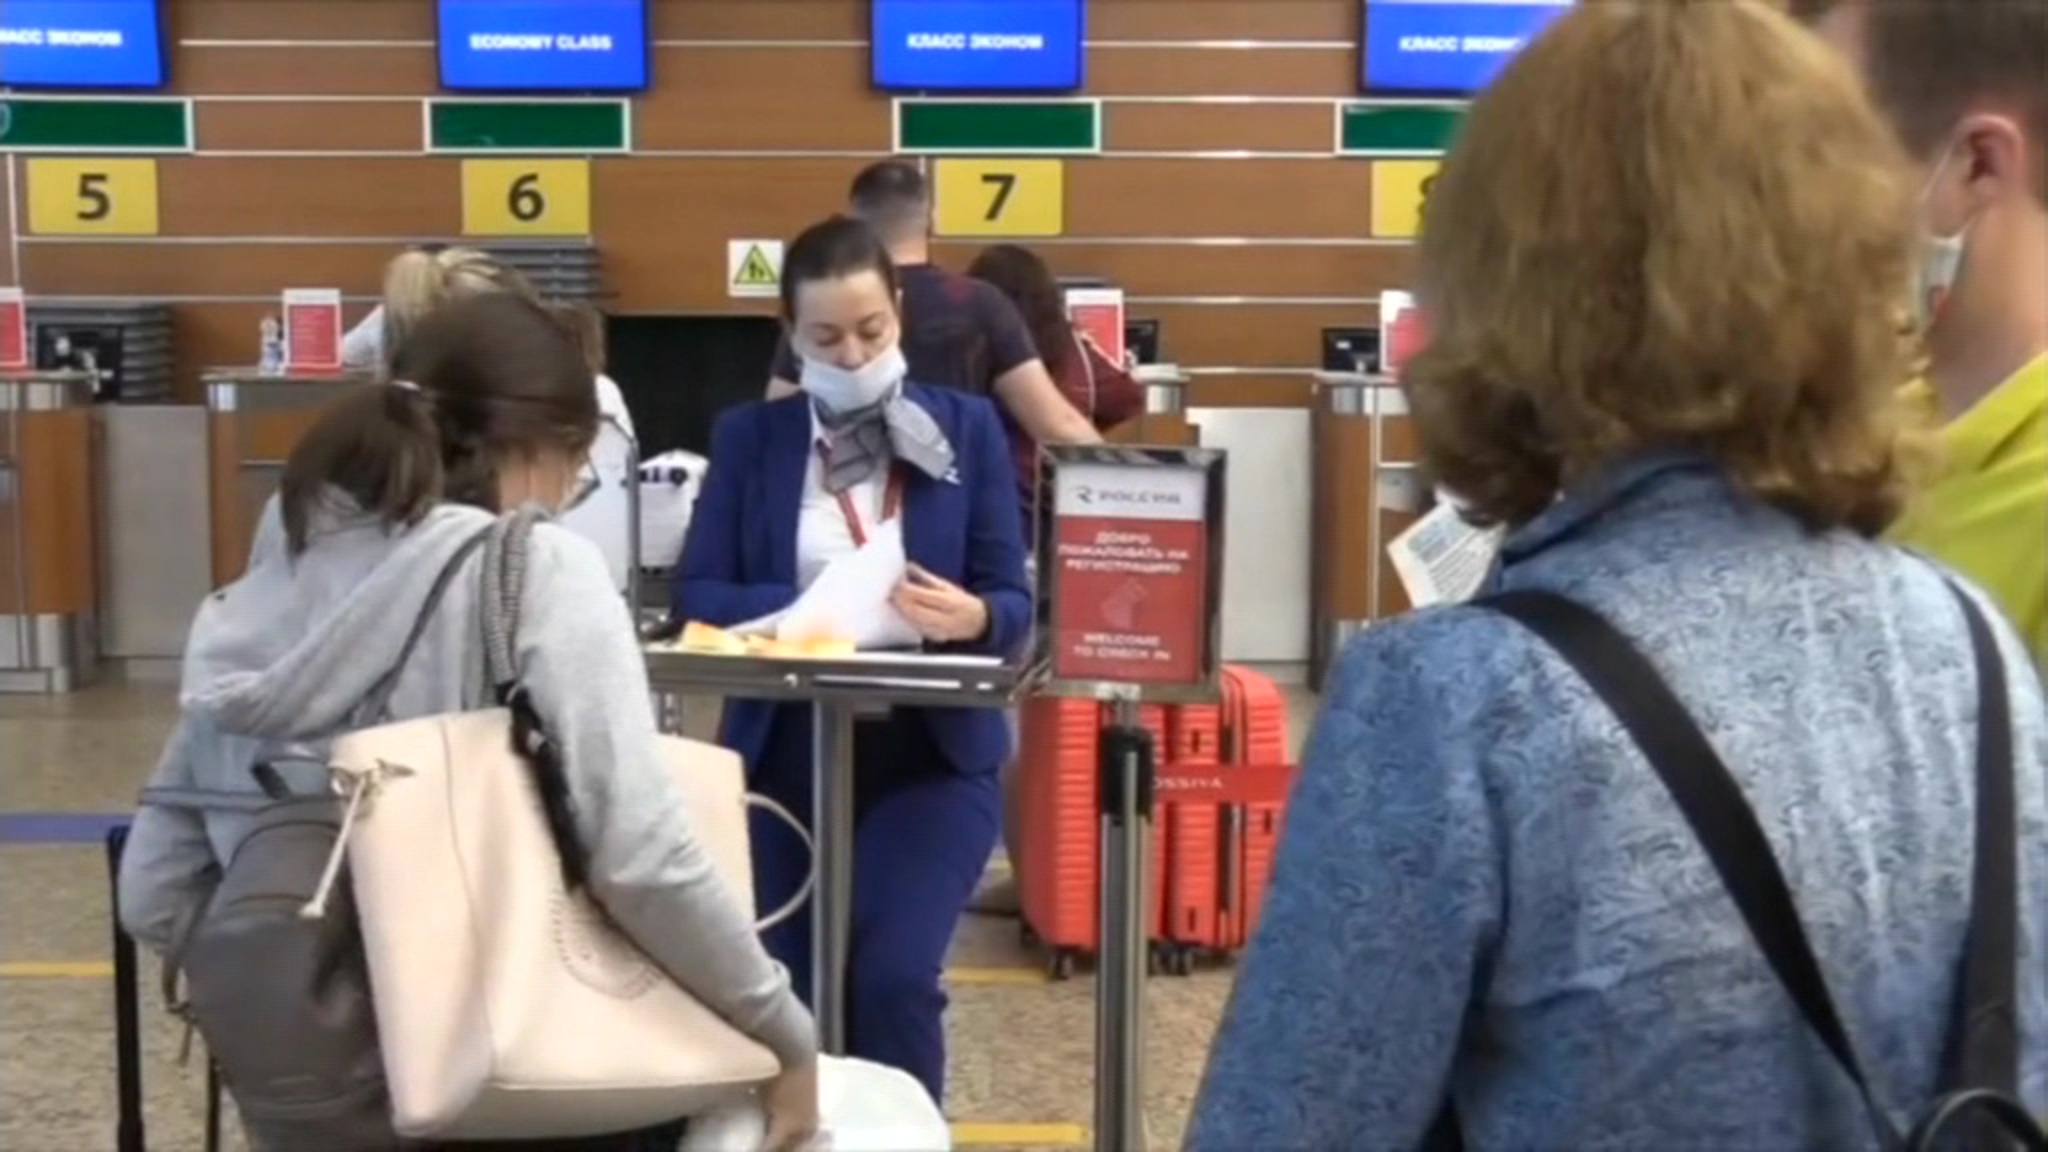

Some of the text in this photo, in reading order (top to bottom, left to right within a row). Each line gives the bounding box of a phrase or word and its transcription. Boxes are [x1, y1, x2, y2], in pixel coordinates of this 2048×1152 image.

[470, 33, 613, 51] ECONOMY CLASS
[907, 32, 1043, 50] КЛАСС ЭКОНОМ
[1399, 35, 1457, 52] КЛАСС
[77, 173, 110, 221] 5
[508, 172, 544, 222] 6
[981, 174, 1016, 221] 7
[1095, 531, 1152, 545] ДОБРО
[1058, 544, 1190, 560] ПОЖАЛОВАТЬ НА
[1084, 632, 1160, 647] WELCOME
[1073, 644, 1094, 657] TO
[1096, 647, 1149, 660] CHECK
